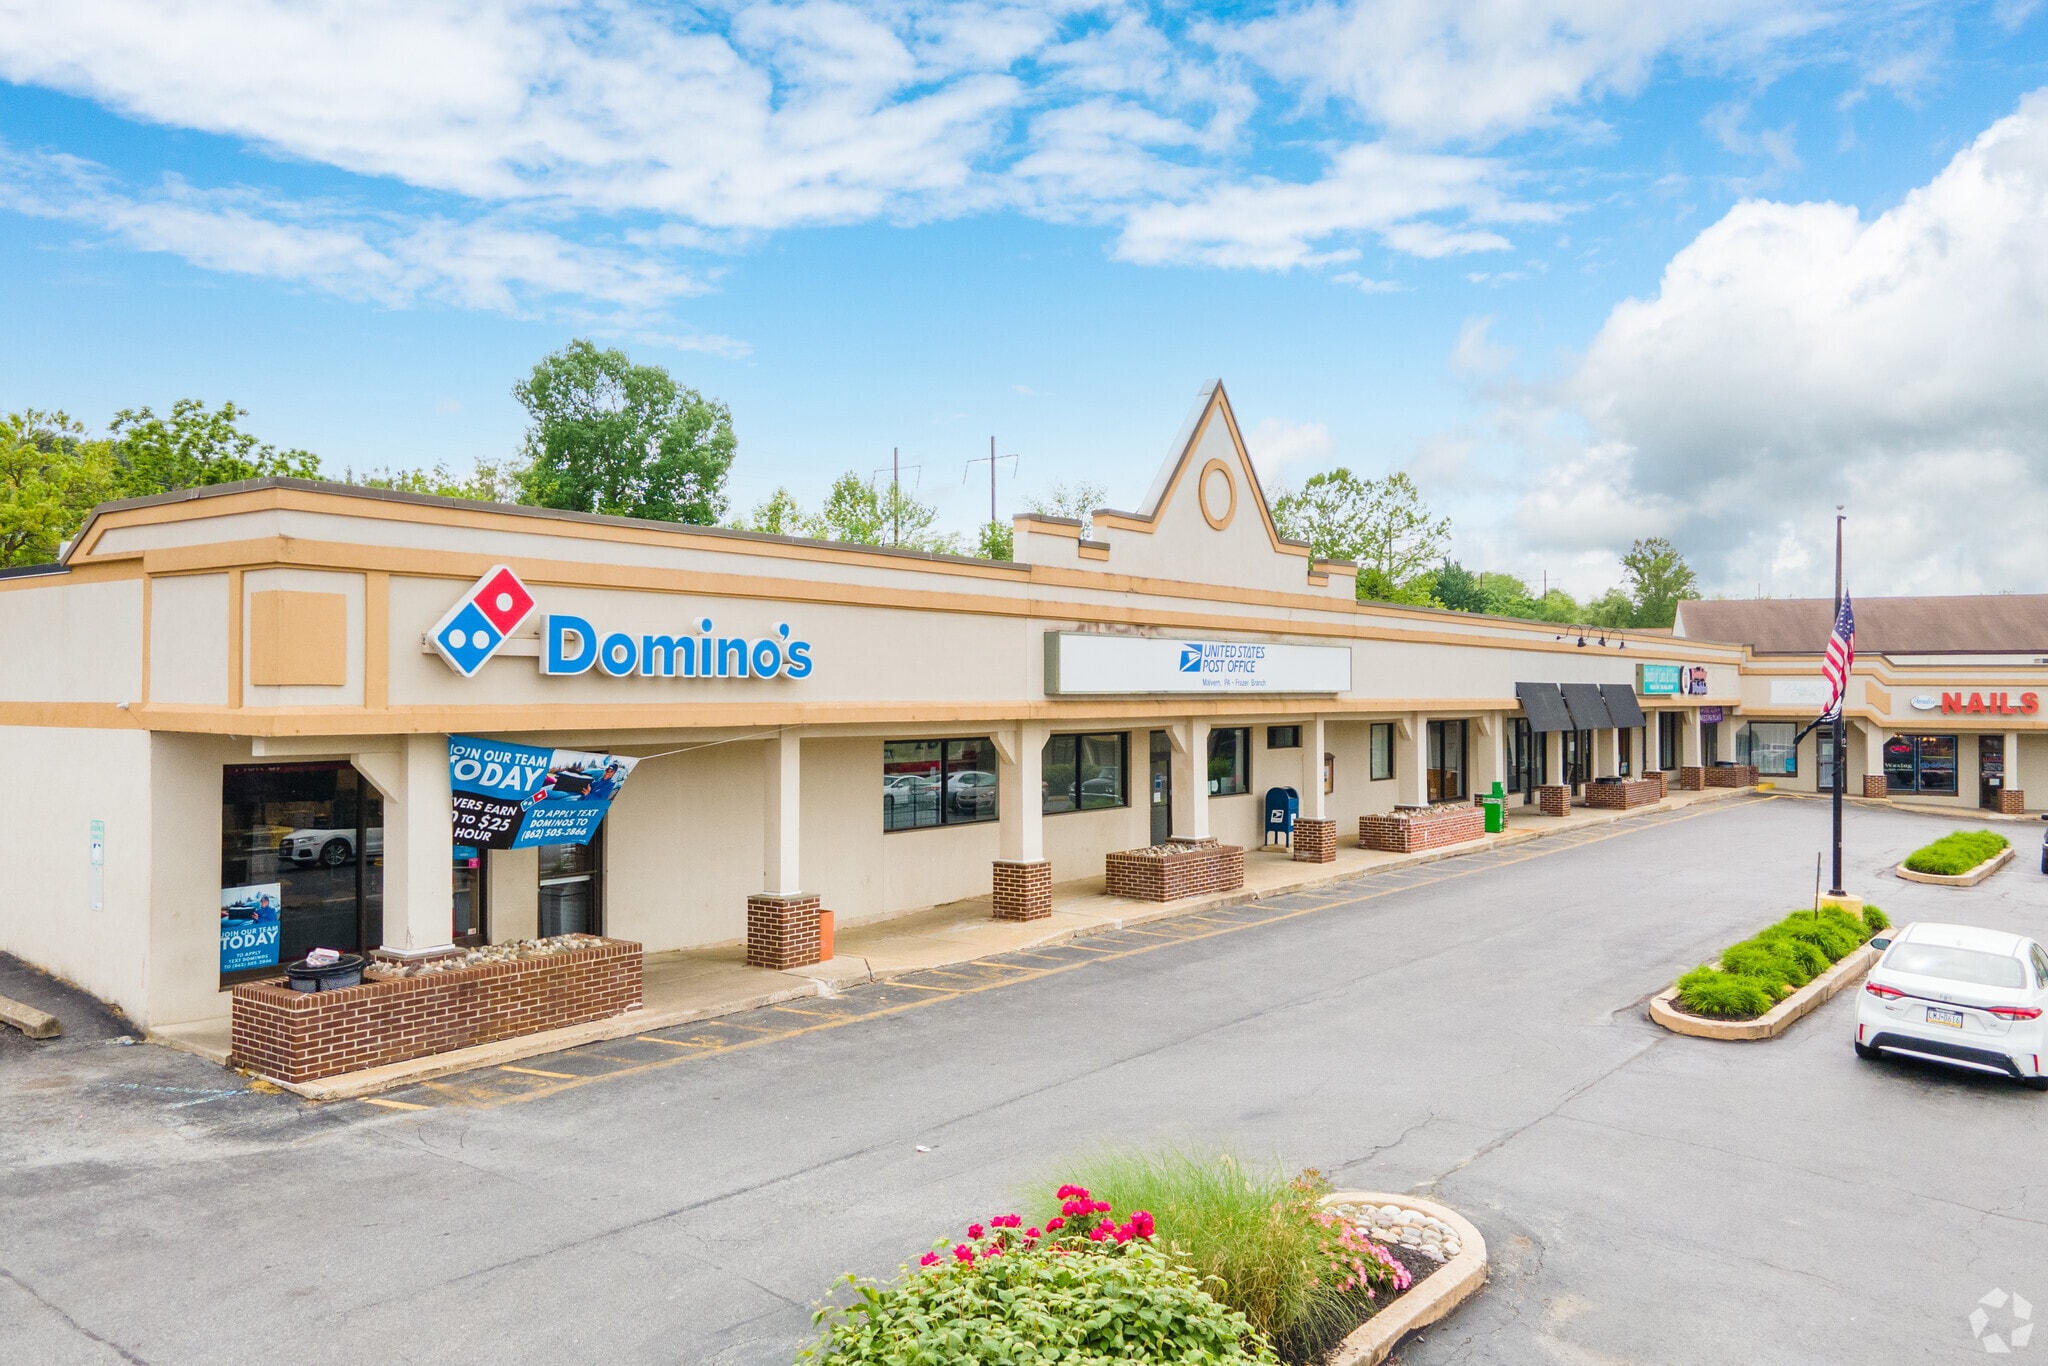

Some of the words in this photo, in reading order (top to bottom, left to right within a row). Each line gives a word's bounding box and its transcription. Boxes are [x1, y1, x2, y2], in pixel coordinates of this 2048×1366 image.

[541, 614, 813, 680] Domino's
[1204, 644, 1236, 657] UNITED
[1238, 645, 1265, 659] STATES
[1203, 660, 1225, 672] POST
[1228, 660, 1256, 673] OFFICE
[1941, 692, 2040, 715] NAILS
[484, 750, 512, 764] OUR
[515, 753, 548, 767] TEAM
[452, 797, 483, 811] VERS
[484, 803, 518, 816] EARN
[532, 809, 545, 818] TO
[545, 809, 576, 818] APPLY
[577, 809, 599, 817] TEXT
[461, 814, 476, 824] TO
[478, 814, 511, 831] $25
[529, 819, 574, 828] DOMINOS
[576, 818, 588, 826] TO
[454, 828, 492, 841] HOUR
[520, 828, 544, 841] (862)
[221, 930, 239, 938] JOIN
[241, 928, 257, 936] OUR
[258, 925, 278, 933] TEAM
[220, 931, 278, 950] TODAY
